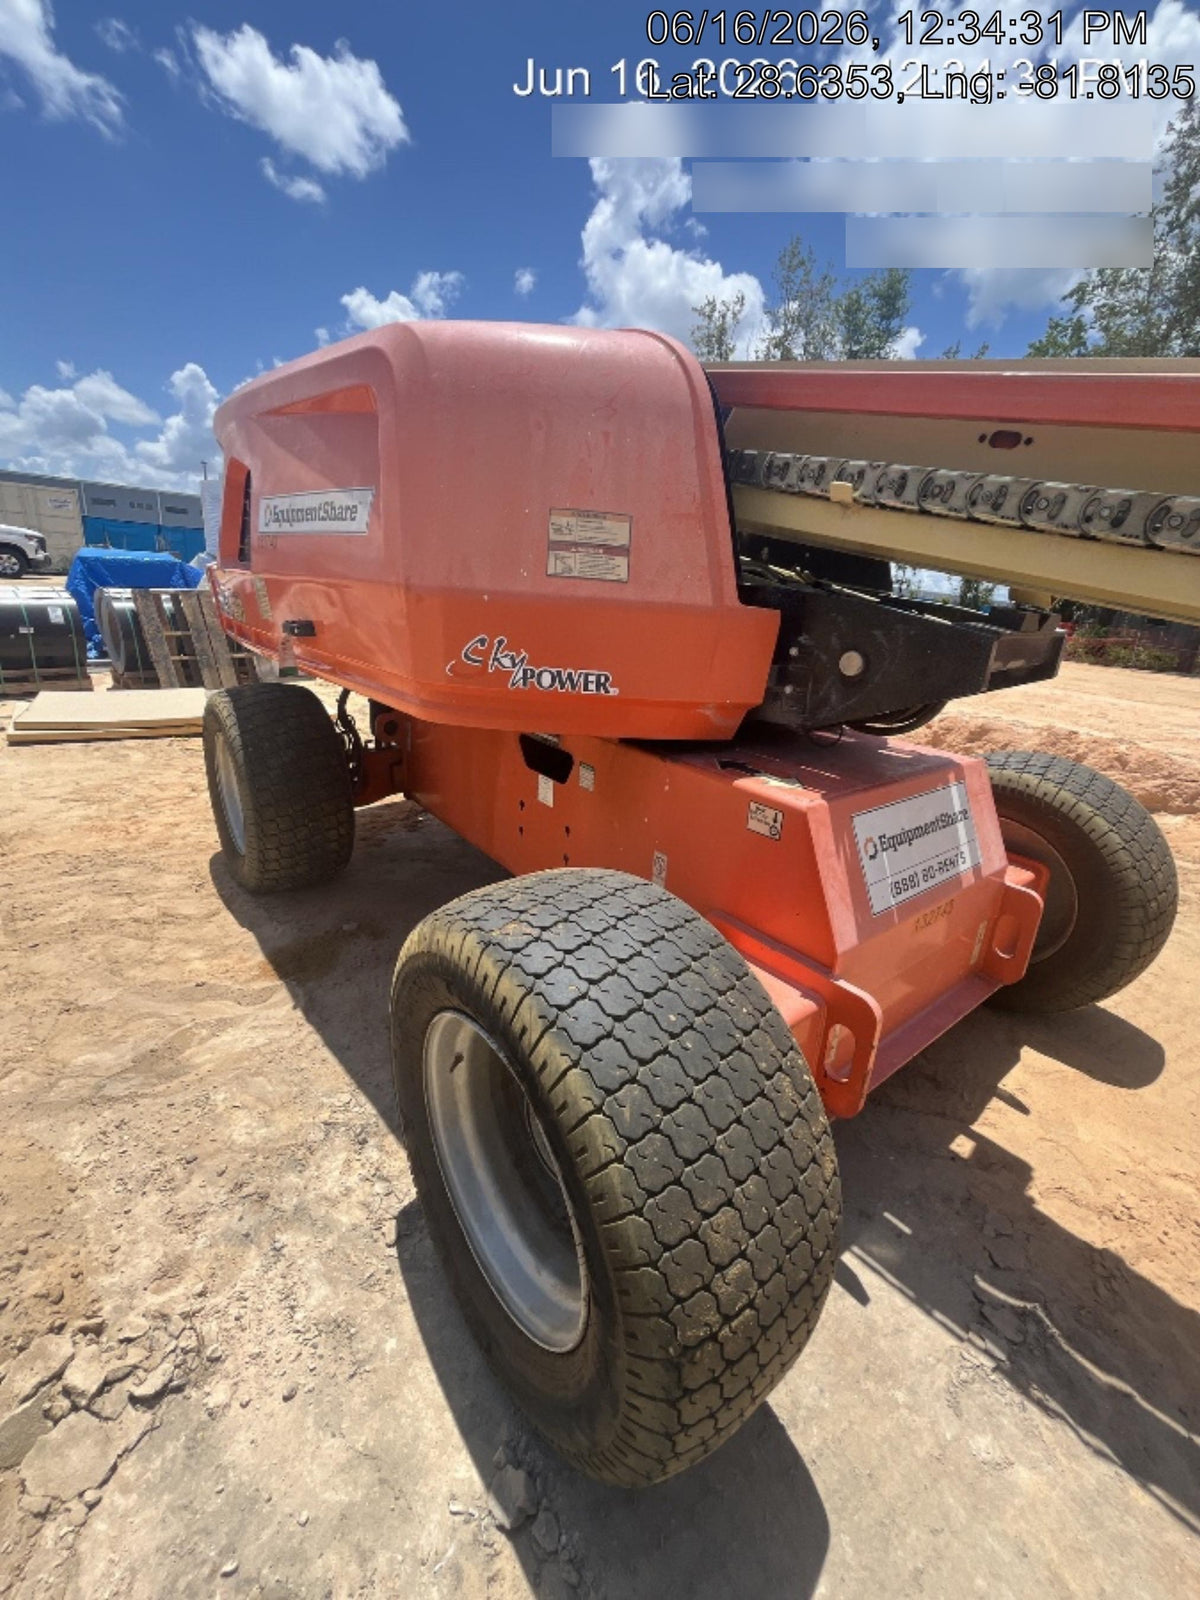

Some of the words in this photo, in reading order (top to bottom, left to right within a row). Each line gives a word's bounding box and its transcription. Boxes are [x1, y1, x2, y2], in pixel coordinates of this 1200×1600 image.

[272, 501, 358, 528] EquipmentShare
[878, 808, 969, 852] EquipmentShare
[889, 871, 920, 899] (888)
